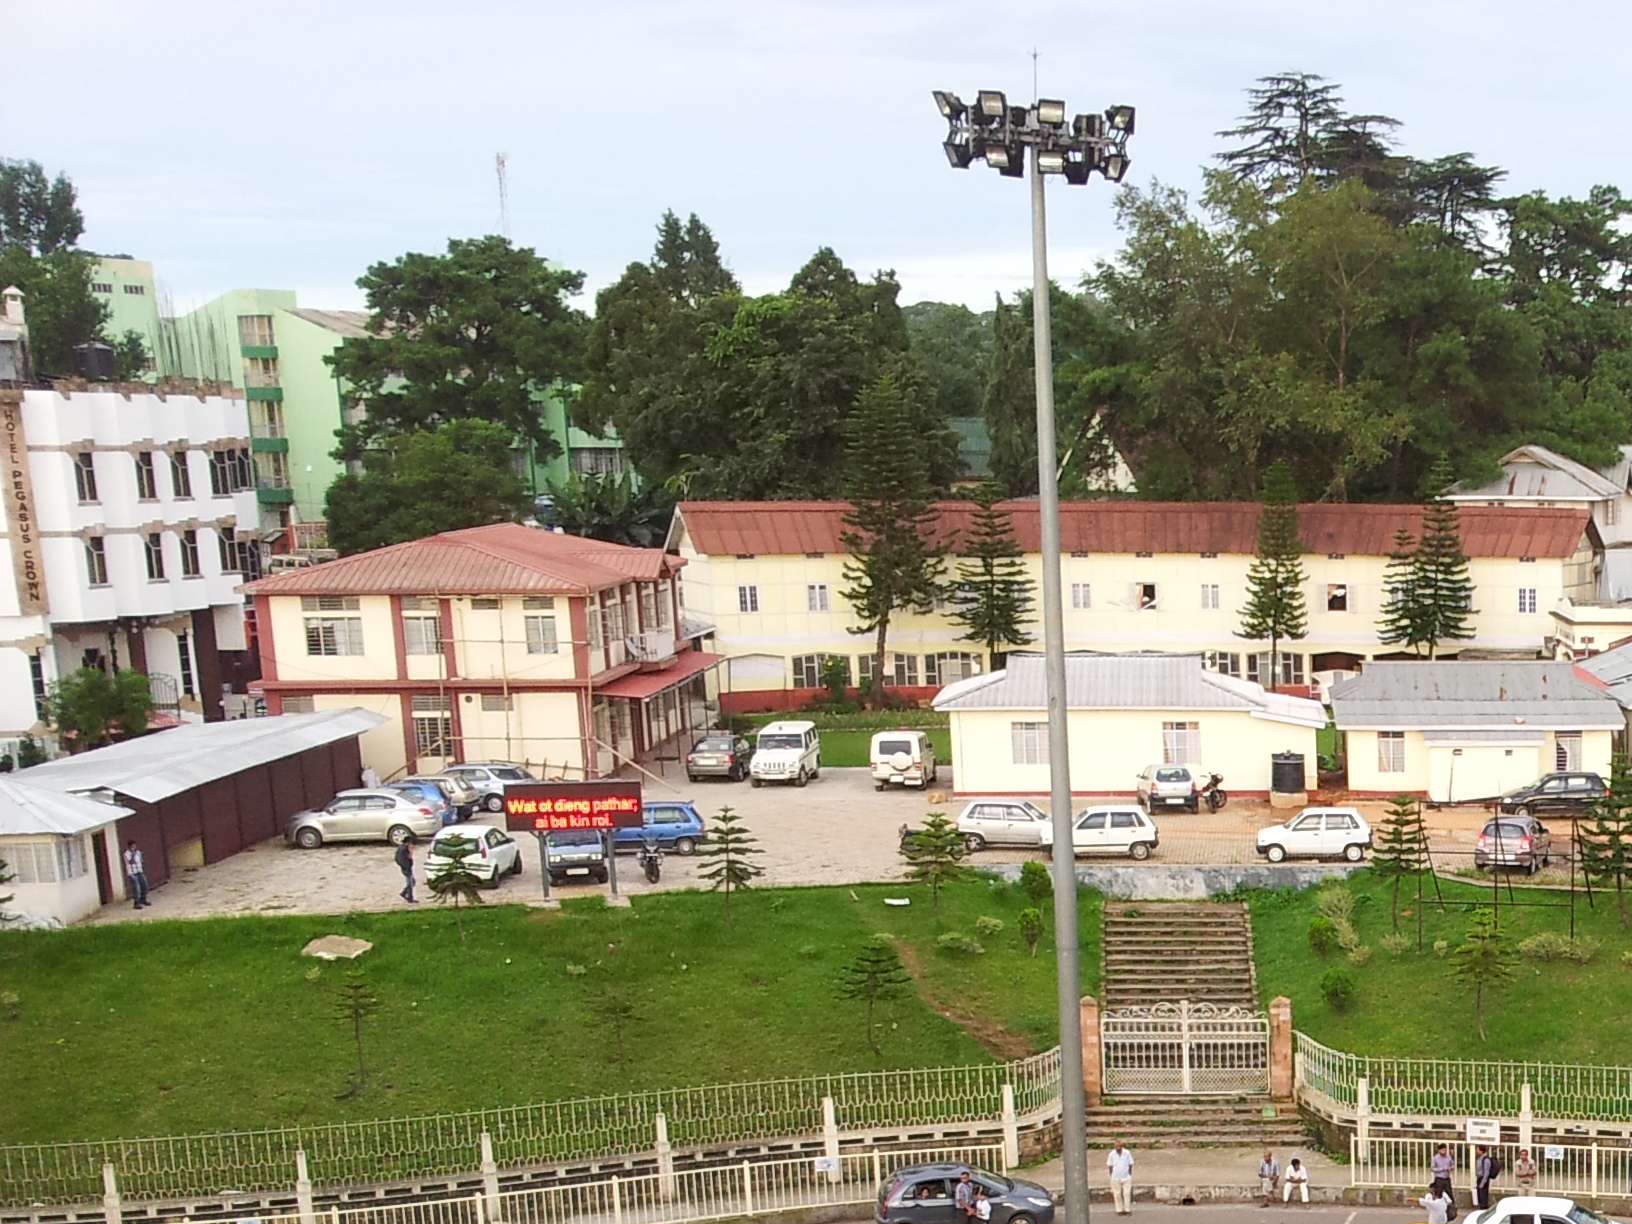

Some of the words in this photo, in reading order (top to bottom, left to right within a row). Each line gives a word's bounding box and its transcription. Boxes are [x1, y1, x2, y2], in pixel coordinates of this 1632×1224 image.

[4, 410, 19, 464] HOTEL
[12, 470, 31, 544] PEGASUS
[24, 550, 40, 602] CROWN
[507, 799, 537, 814] Wat
[549, 814, 568, 828] ba
